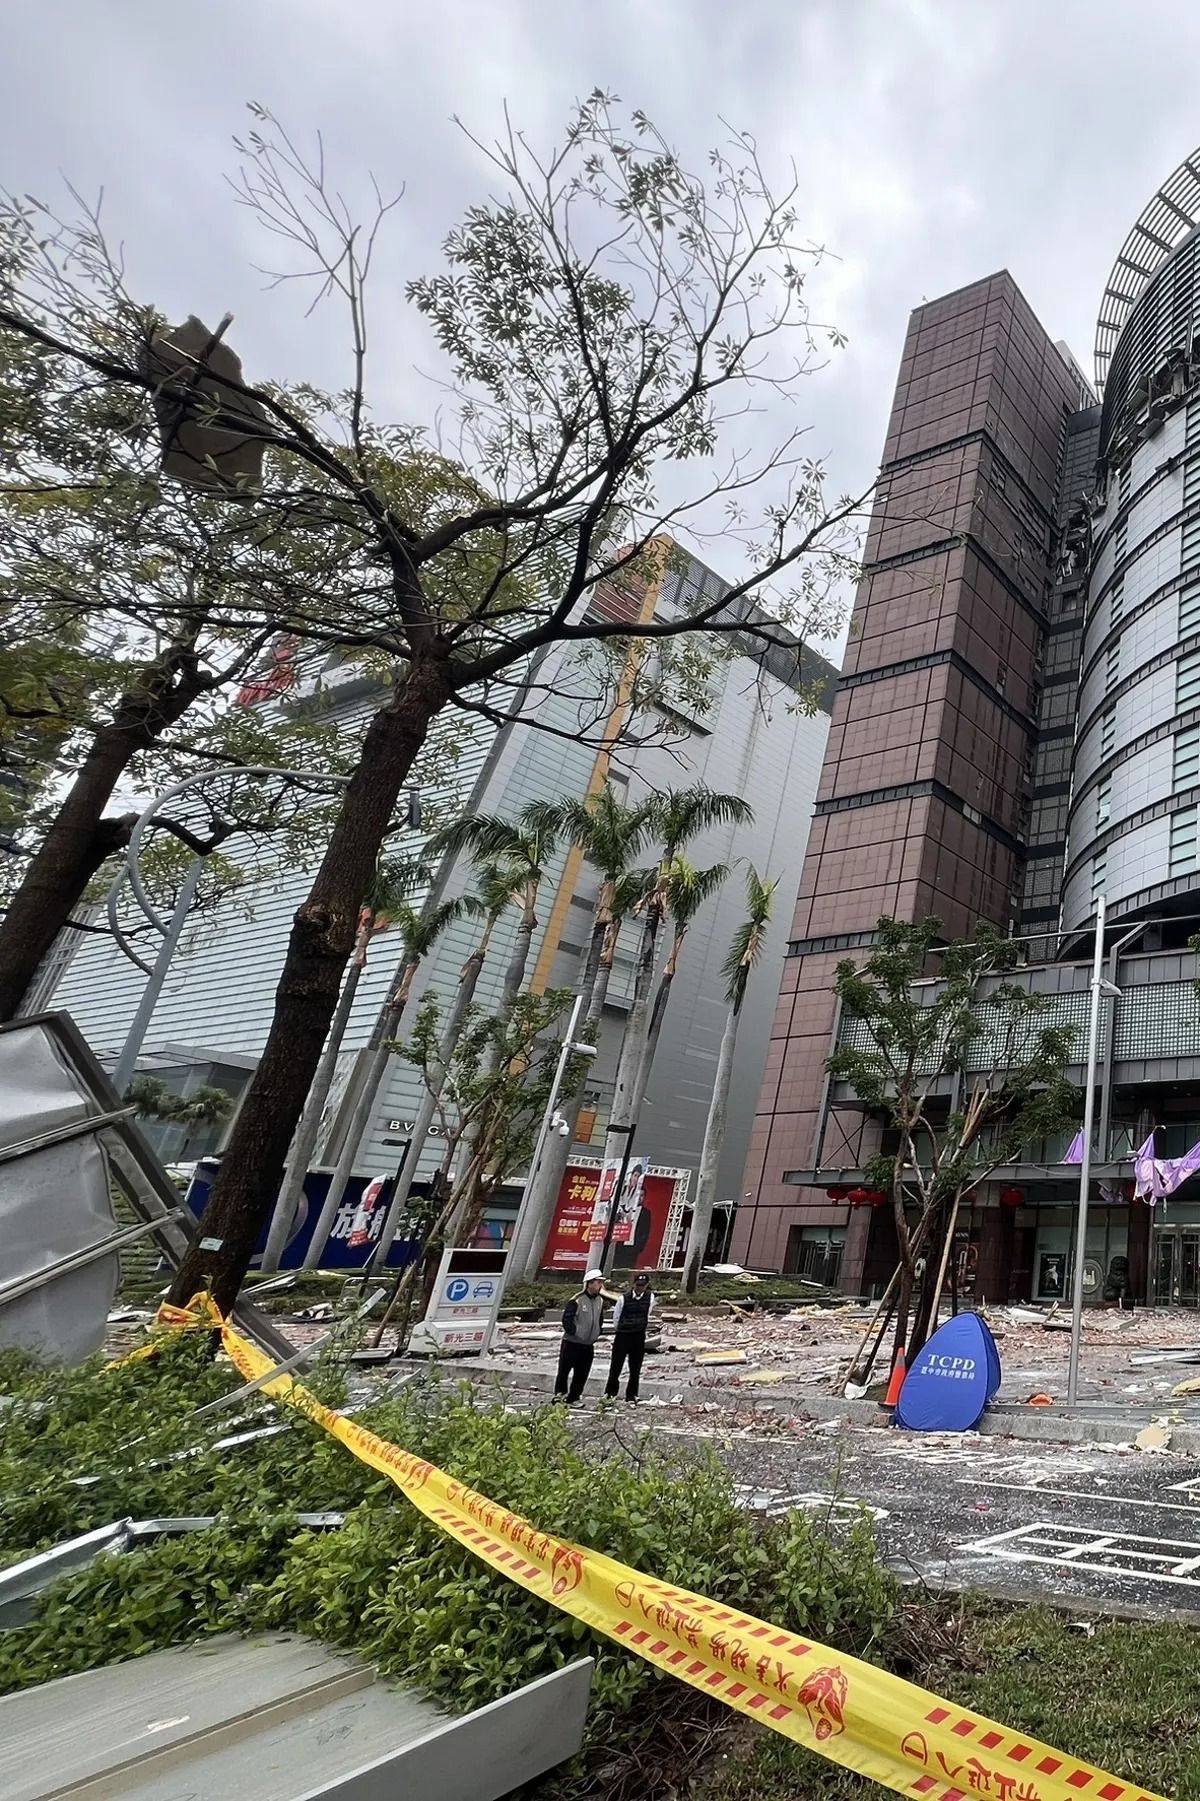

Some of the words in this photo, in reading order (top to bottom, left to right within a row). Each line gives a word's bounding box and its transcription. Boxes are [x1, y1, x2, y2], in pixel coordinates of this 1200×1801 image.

[444, 1332, 484, 1344] 新光三越
[928, 1353, 975, 1371] TCPD
[638, 1593, 703, 1649] 禁止進入
